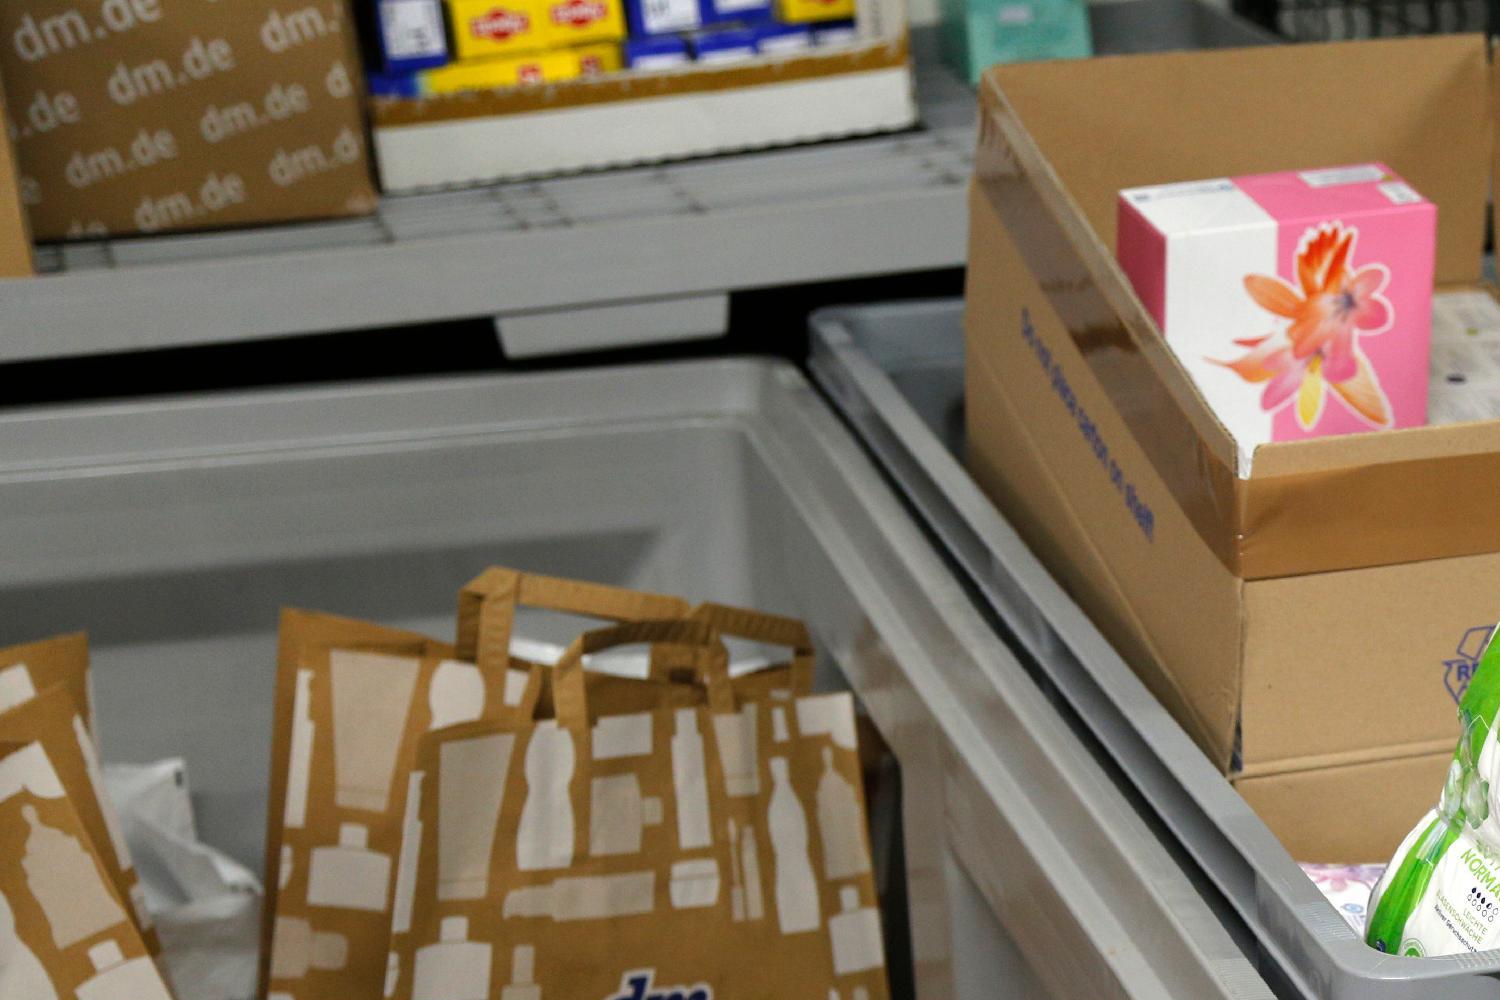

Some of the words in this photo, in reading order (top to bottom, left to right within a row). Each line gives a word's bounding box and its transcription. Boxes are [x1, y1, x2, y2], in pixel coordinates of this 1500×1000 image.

[107, 36, 236, 105] dm.de
[201, 82, 308, 142] dm.de
[65, 128, 178, 188] dm.de
[268, 128, 360, 186] dm.d
[134, 171, 244, 232] dm.de
